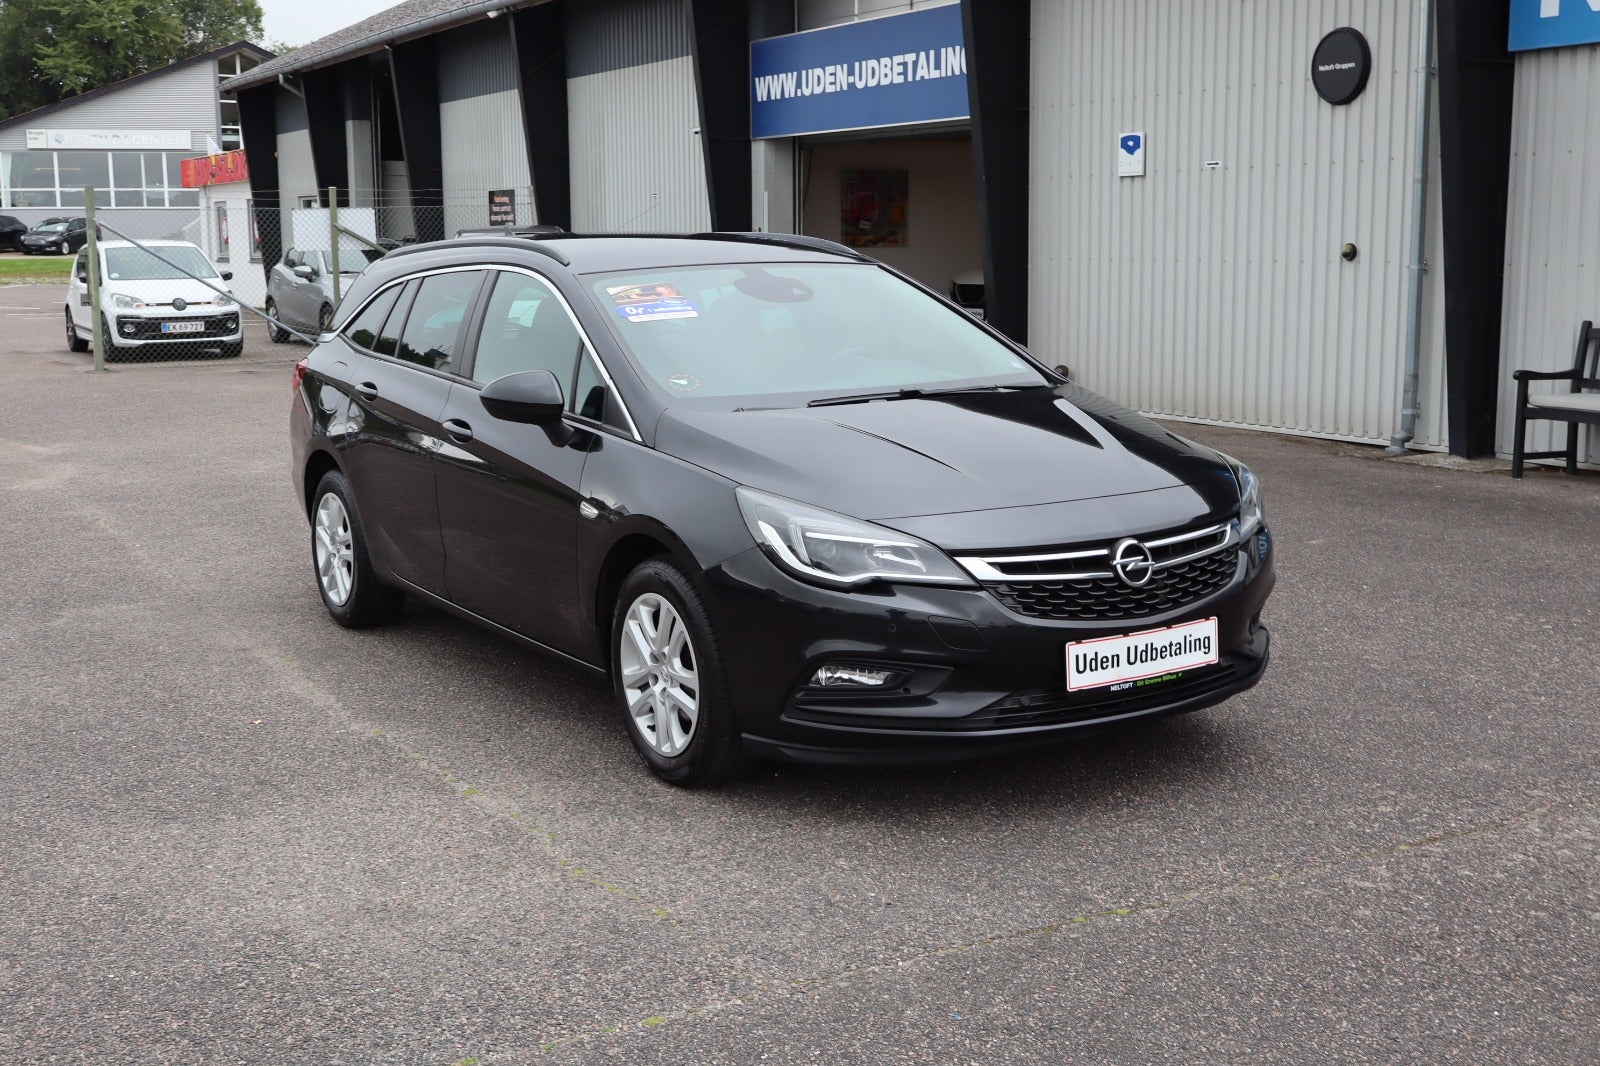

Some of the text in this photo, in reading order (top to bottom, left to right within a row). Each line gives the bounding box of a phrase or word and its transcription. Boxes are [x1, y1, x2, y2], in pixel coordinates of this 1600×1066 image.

[179, 323, 188, 331] 69
[190, 323, 203, 331] 727
[1075, 634, 1211, 675] Uden Udbetaling
[1110, 682, 1134, 692] NELTOFT
